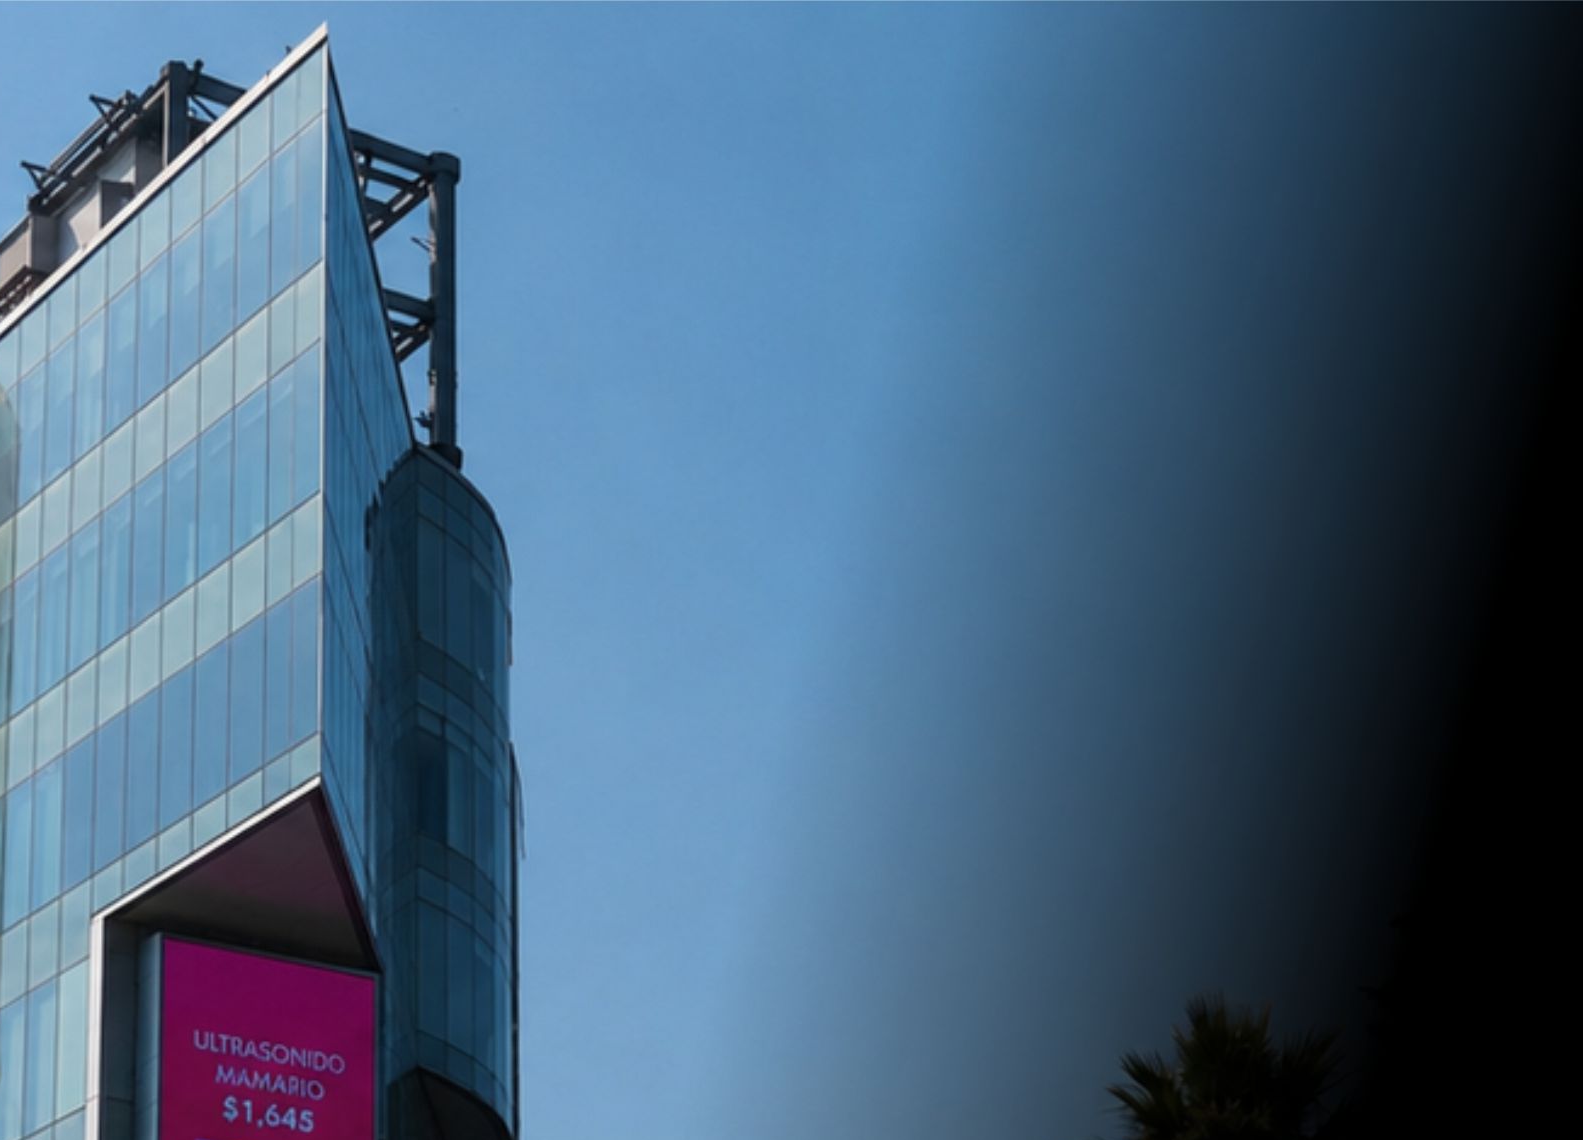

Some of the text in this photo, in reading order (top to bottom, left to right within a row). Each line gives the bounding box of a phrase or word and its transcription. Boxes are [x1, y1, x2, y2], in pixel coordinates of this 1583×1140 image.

[193, 1029, 346, 1075] ULTRASONIDO
[215, 1064, 326, 1100] MAMARIO
[222, 1095, 315, 1134] $1,645
